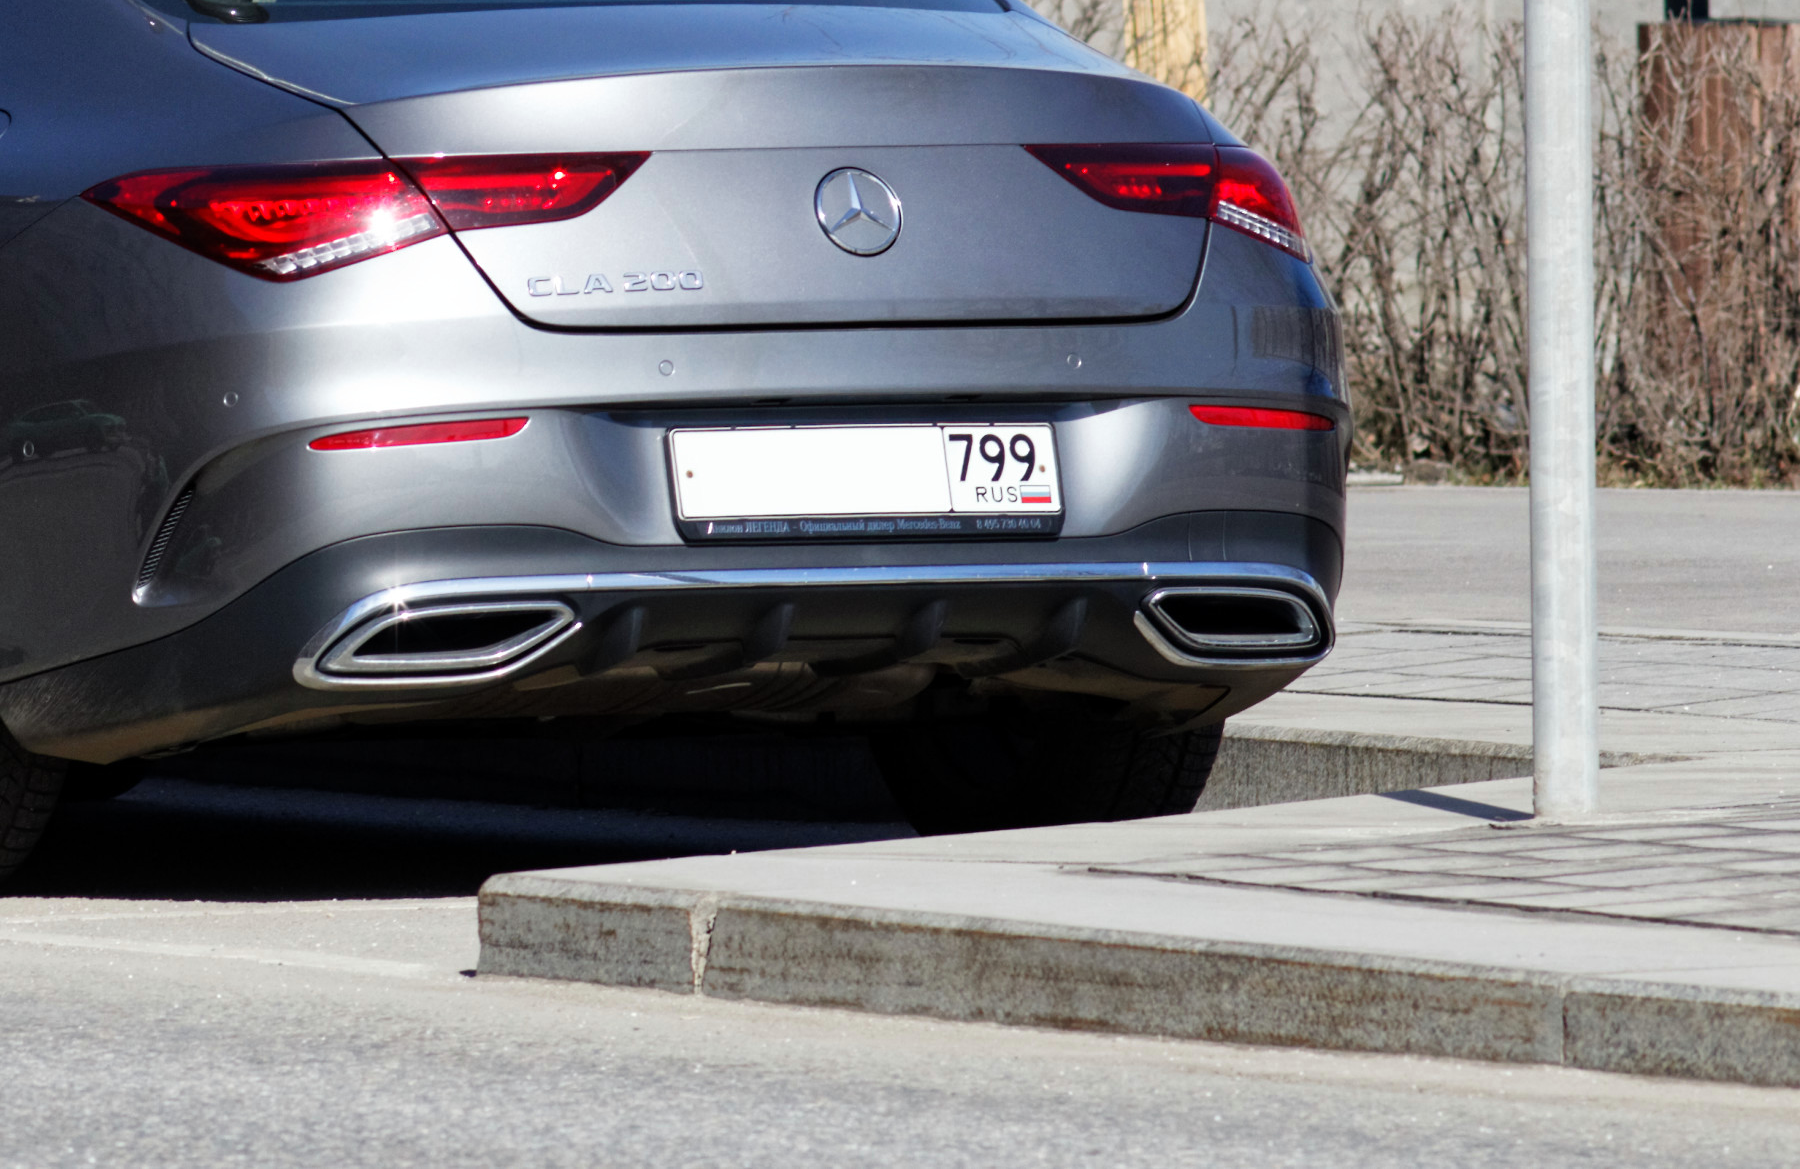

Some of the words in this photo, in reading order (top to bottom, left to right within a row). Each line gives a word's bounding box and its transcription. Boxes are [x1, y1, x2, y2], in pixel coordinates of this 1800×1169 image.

[527, 273, 614, 297] CLA
[623, 270, 704, 293] 200
[948, 433, 1036, 482] 799
[975, 486, 1018, 503] RUS
[745, 521, 790, 534] ЛЕГЕНДА
[799, 519, 865, 535] Официальный
[867, 520, 895, 533] дилер
[896, 518, 961, 530] Mercedes-Benz
